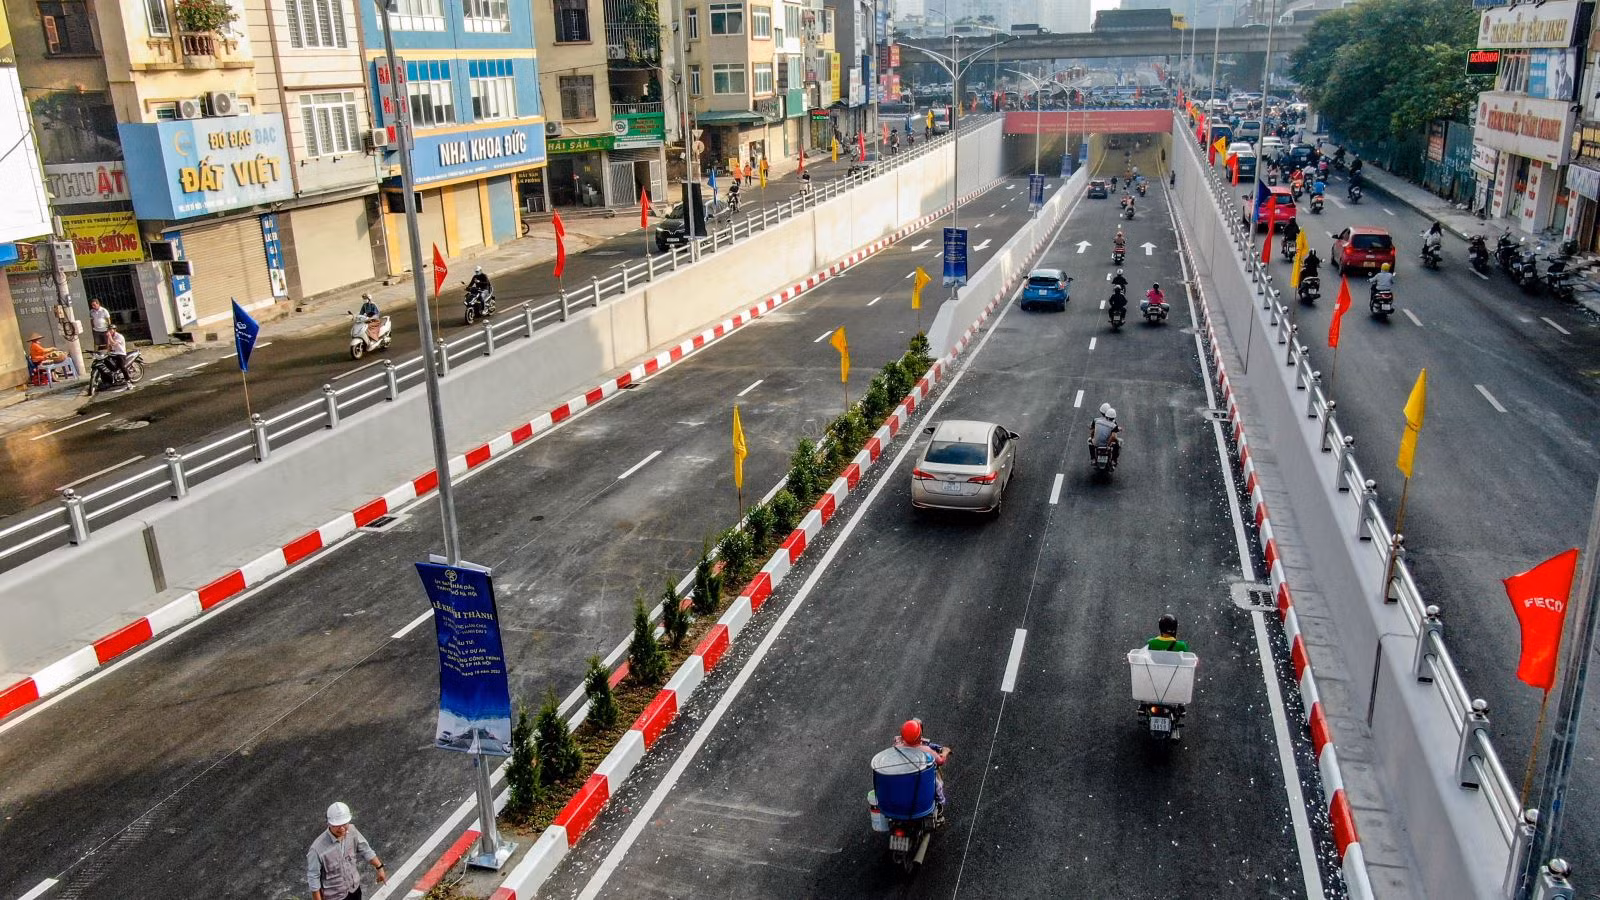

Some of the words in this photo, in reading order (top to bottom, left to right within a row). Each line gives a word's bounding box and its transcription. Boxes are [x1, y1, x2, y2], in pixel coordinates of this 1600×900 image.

[438, 141, 469, 167] NHA
[469, 135, 503, 163] KHOA
[503, 129, 527, 157] ĐỨC
[179, 155, 224, 193] ĐẤT
[231, 153, 281, 189] VIỆT
[462, 609, 494, 621] THÀNH
